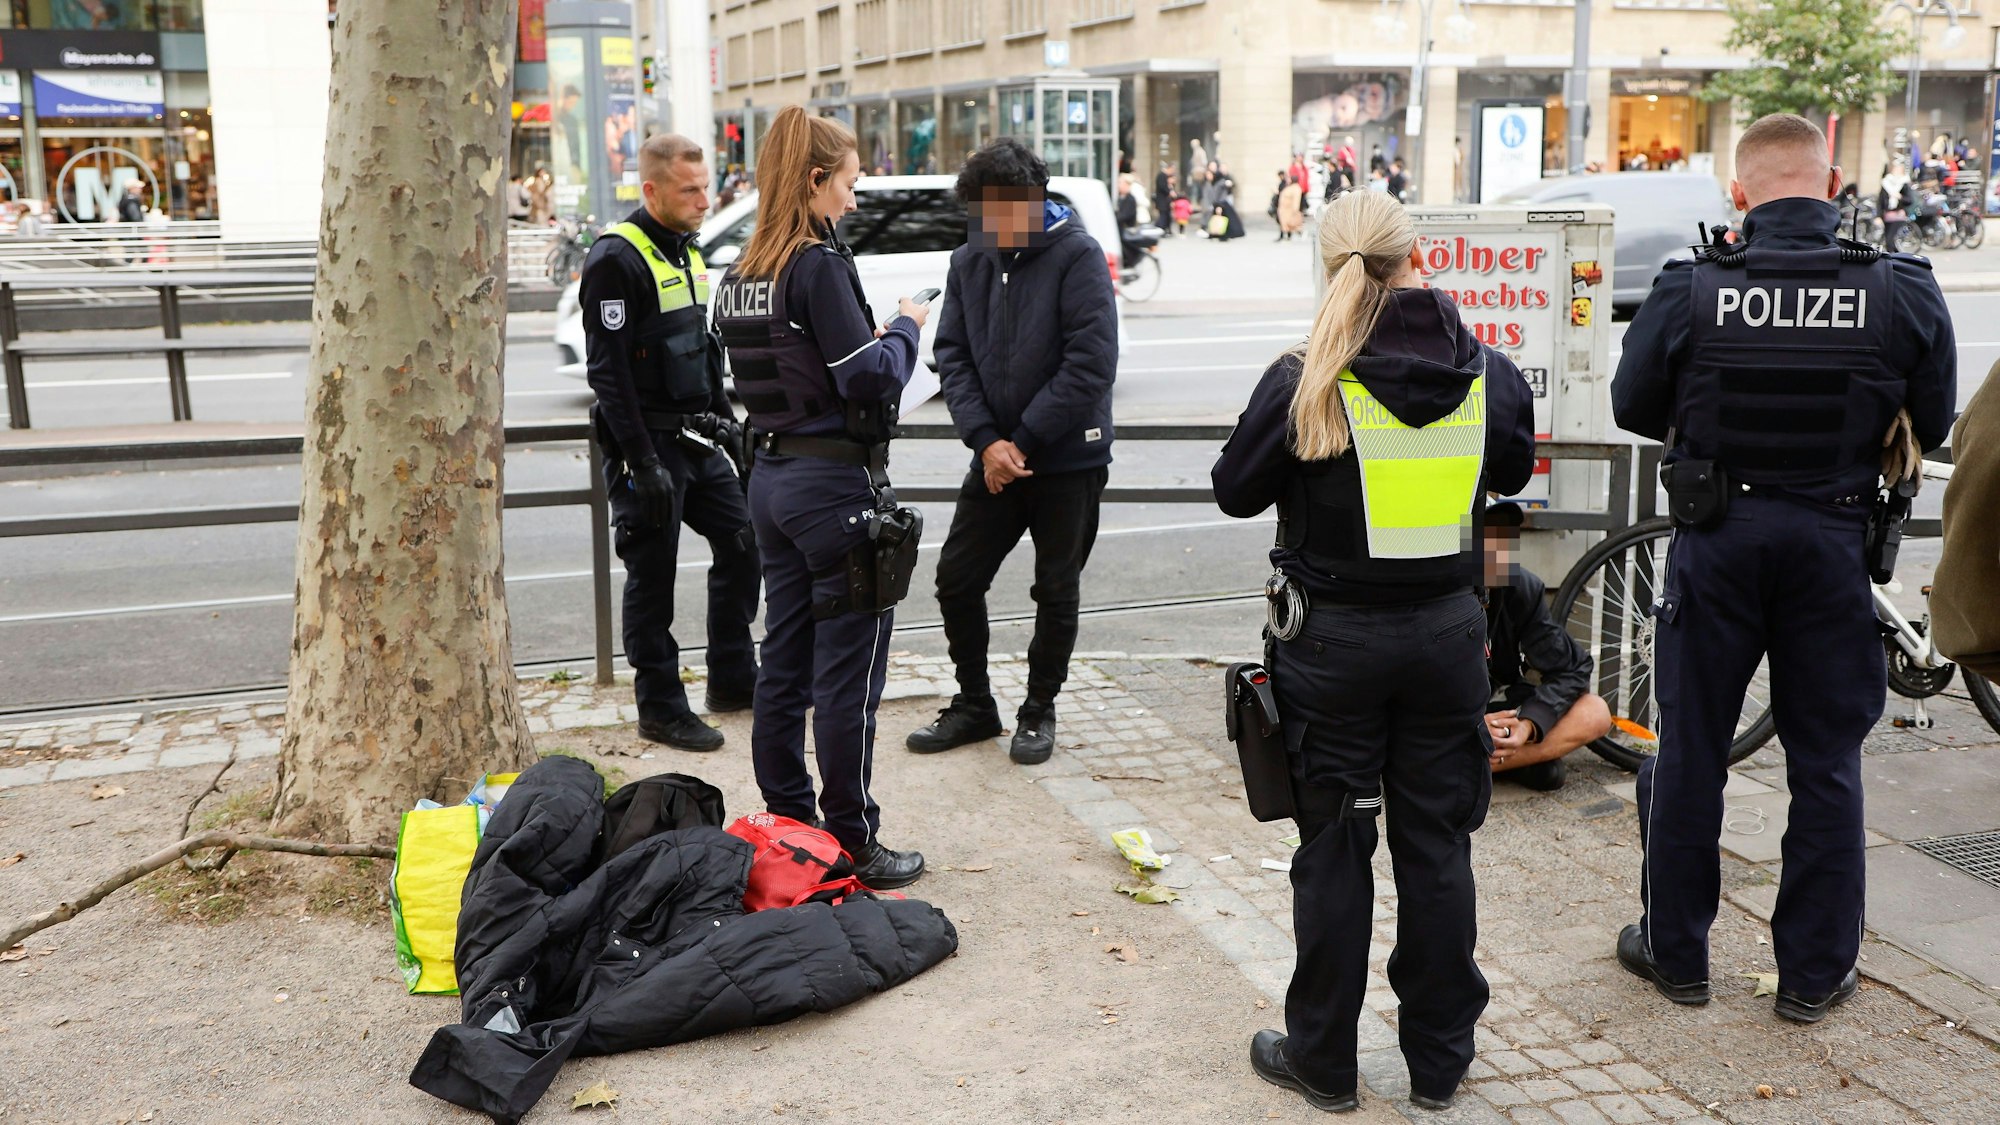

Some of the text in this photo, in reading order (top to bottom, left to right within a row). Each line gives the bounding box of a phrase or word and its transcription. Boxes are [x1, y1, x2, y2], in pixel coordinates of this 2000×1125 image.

[63, 51, 155, 66] Mayersche.de
[716, 281, 774, 318] POLIZEI
[1716, 287, 1867, 328] POLIZEI
[1523, 369, 1543, 384] 31
[1351, 391, 1482, 426] ORDAMT
